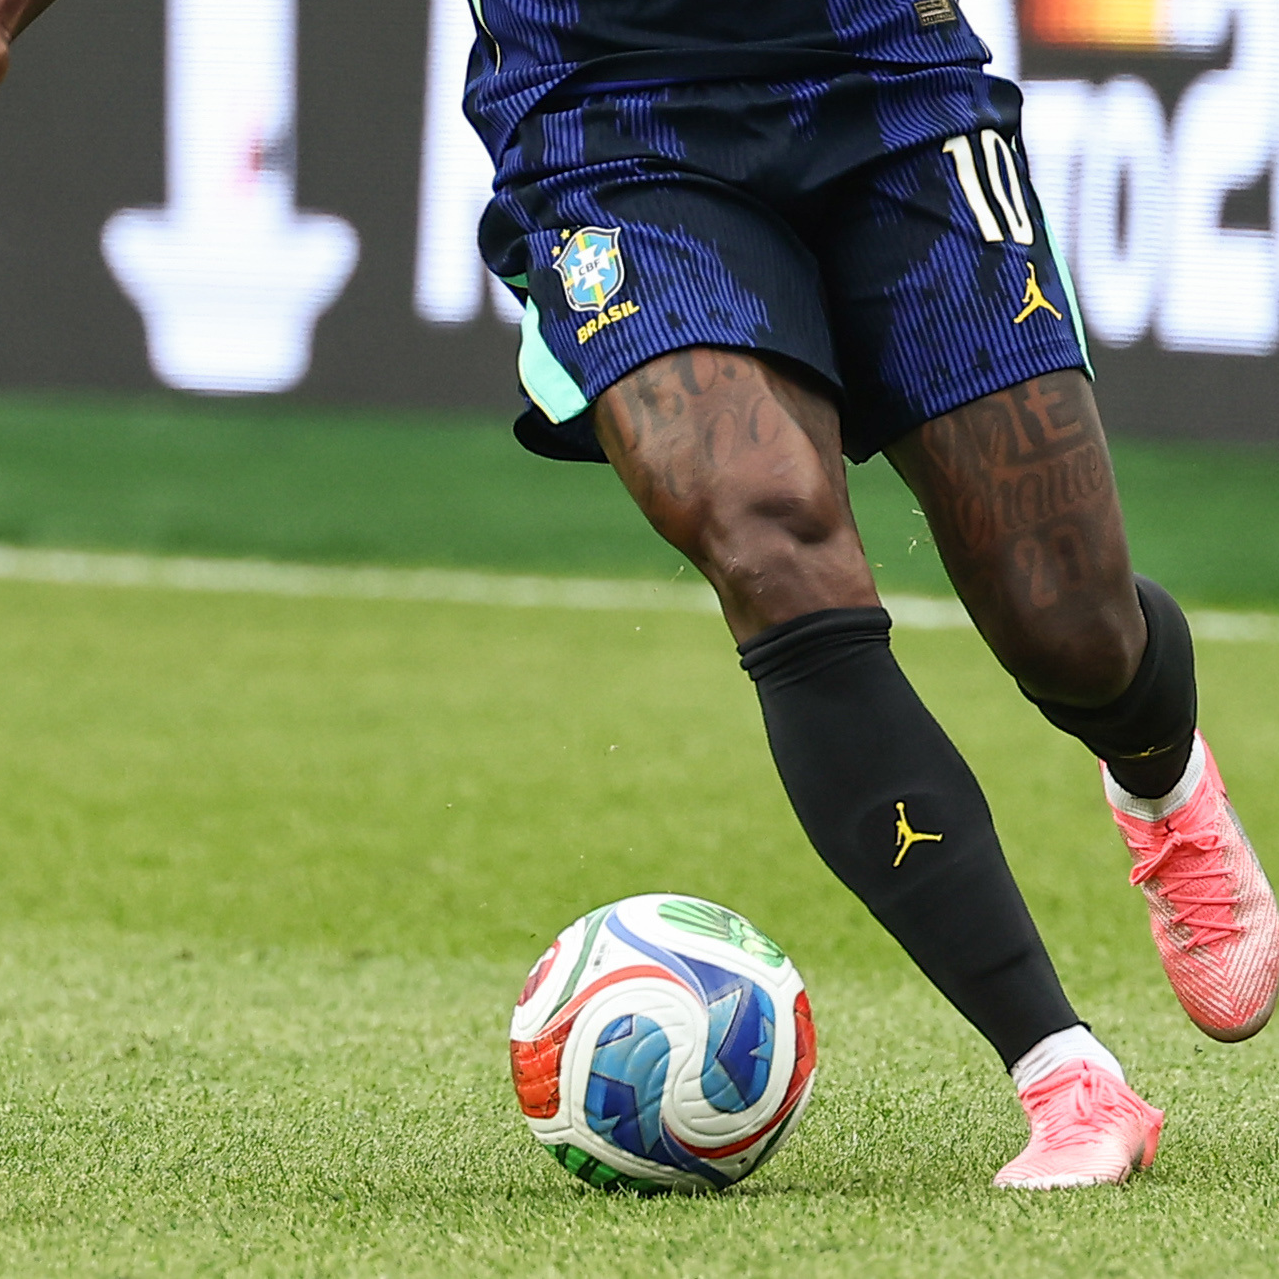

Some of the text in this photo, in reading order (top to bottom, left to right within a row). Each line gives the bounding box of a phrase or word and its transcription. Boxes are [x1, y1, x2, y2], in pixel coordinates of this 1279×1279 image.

[942, 128, 1034, 246] 10
[578, 258, 601, 276] CBF
[576, 300, 640, 345] BRASIL
